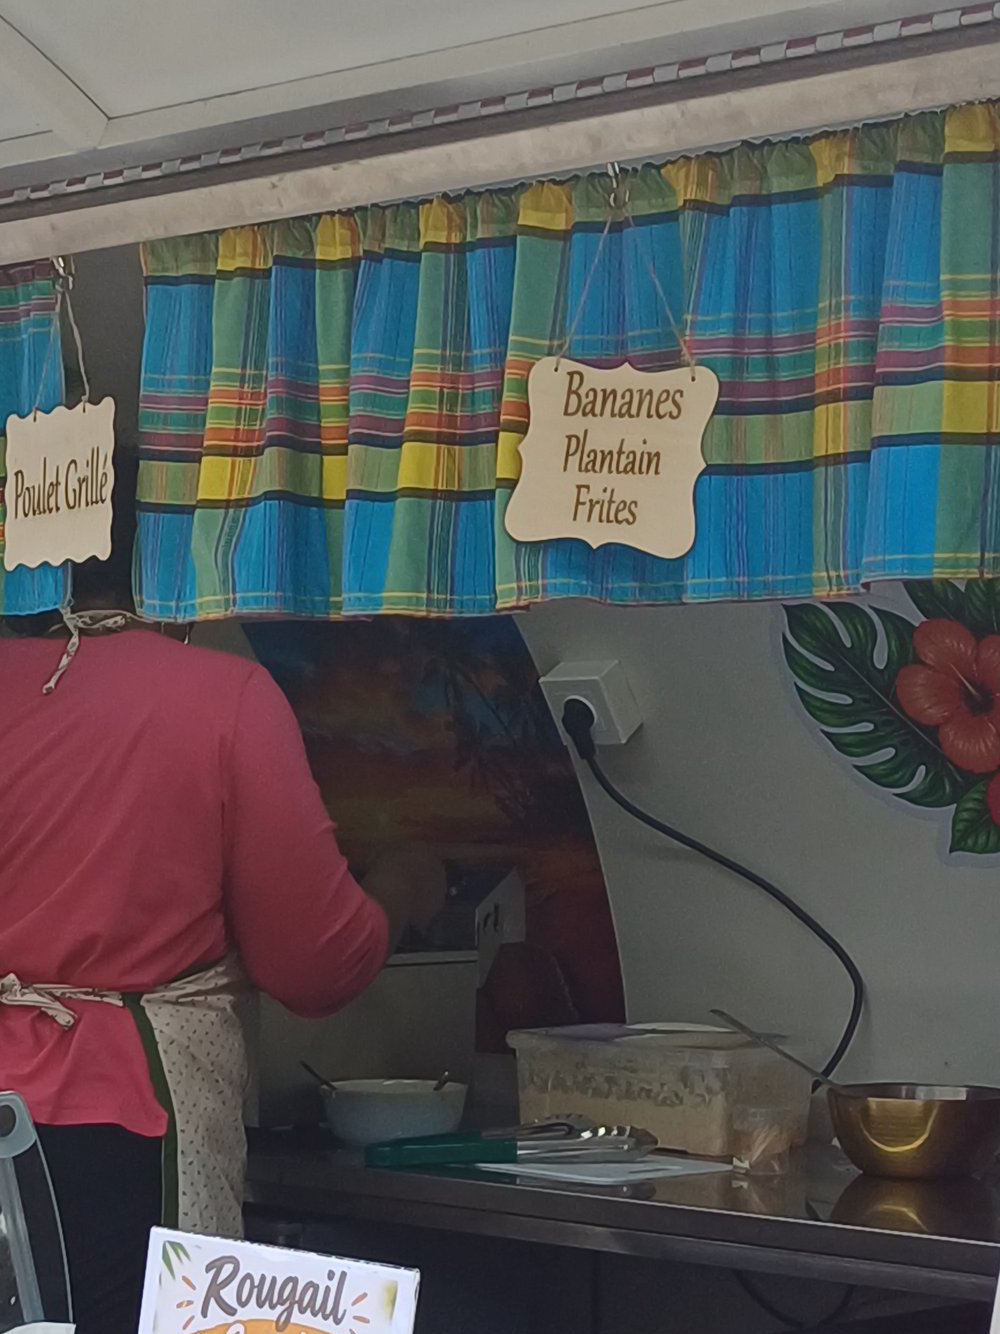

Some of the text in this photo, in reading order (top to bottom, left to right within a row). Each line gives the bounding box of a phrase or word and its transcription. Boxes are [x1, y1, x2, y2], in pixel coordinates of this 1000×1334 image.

[563, 370, 684, 420] Bananes
[563, 429, 661, 475] Plantain
[14, 446, 108, 520] Poulet Grillé
[572, 484, 638, 525] Frites
[199, 1255, 349, 1333] Rougail
